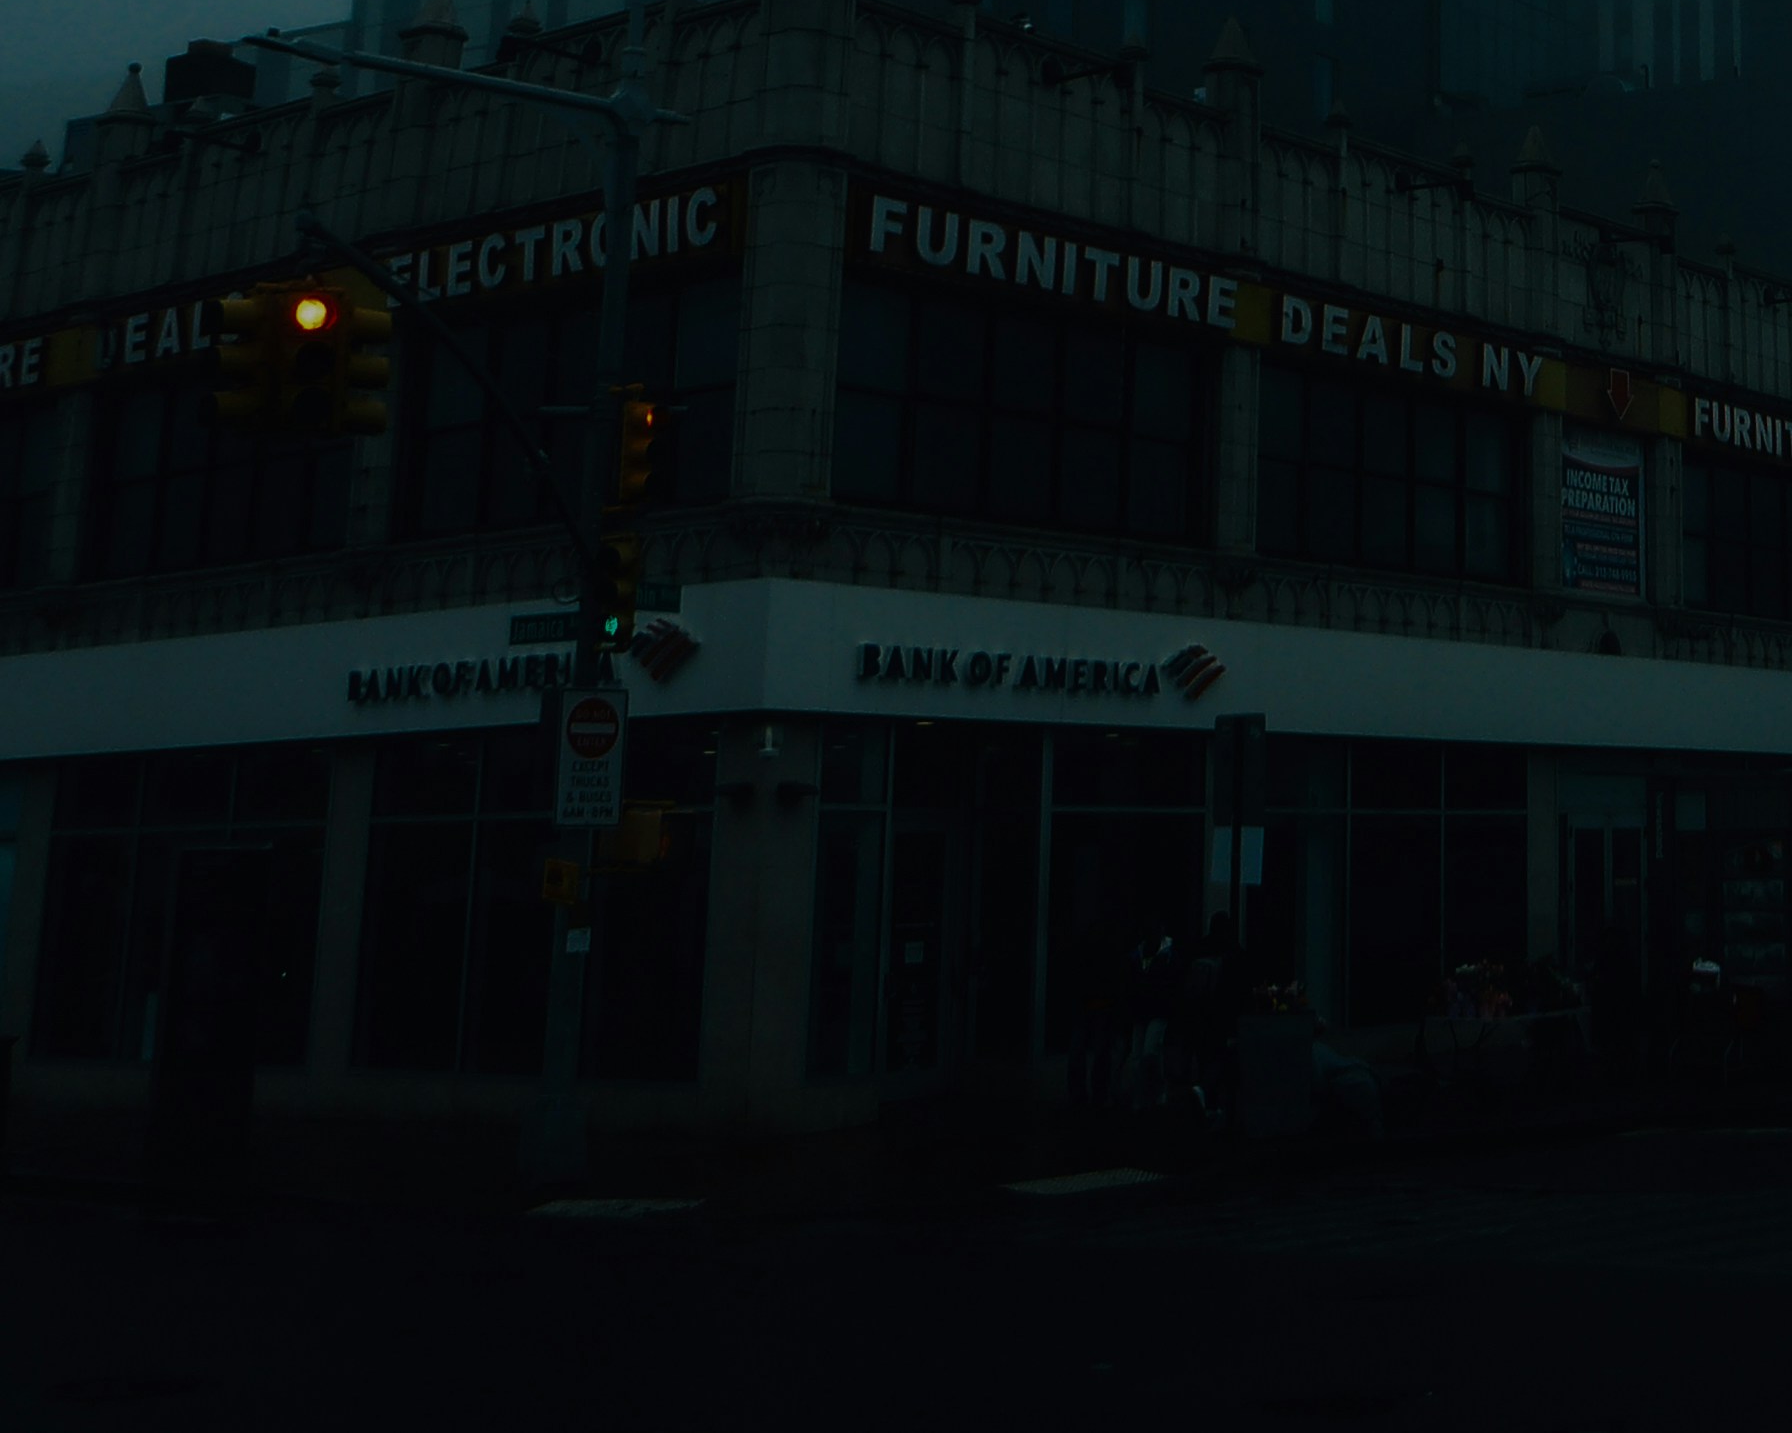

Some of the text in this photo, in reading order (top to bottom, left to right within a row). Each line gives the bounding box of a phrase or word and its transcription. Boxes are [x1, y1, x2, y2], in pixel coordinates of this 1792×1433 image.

[868, 193, 1545, 398] FURNITURE DEALS NY
[1566, 467, 1630, 497] INCOME TAX
[1560, 486, 1637, 518] PREPARATION
[513, 617, 565, 642] Jamaica
[347, 650, 616, 702] BANK OF AMERIA
[857, 643, 1162, 695] BANK OF AMERICA
[572, 775, 609, 787] TRUCKS
[573, 761, 609, 772] EXCEPT
[580, 791, 612, 803] BUSES
